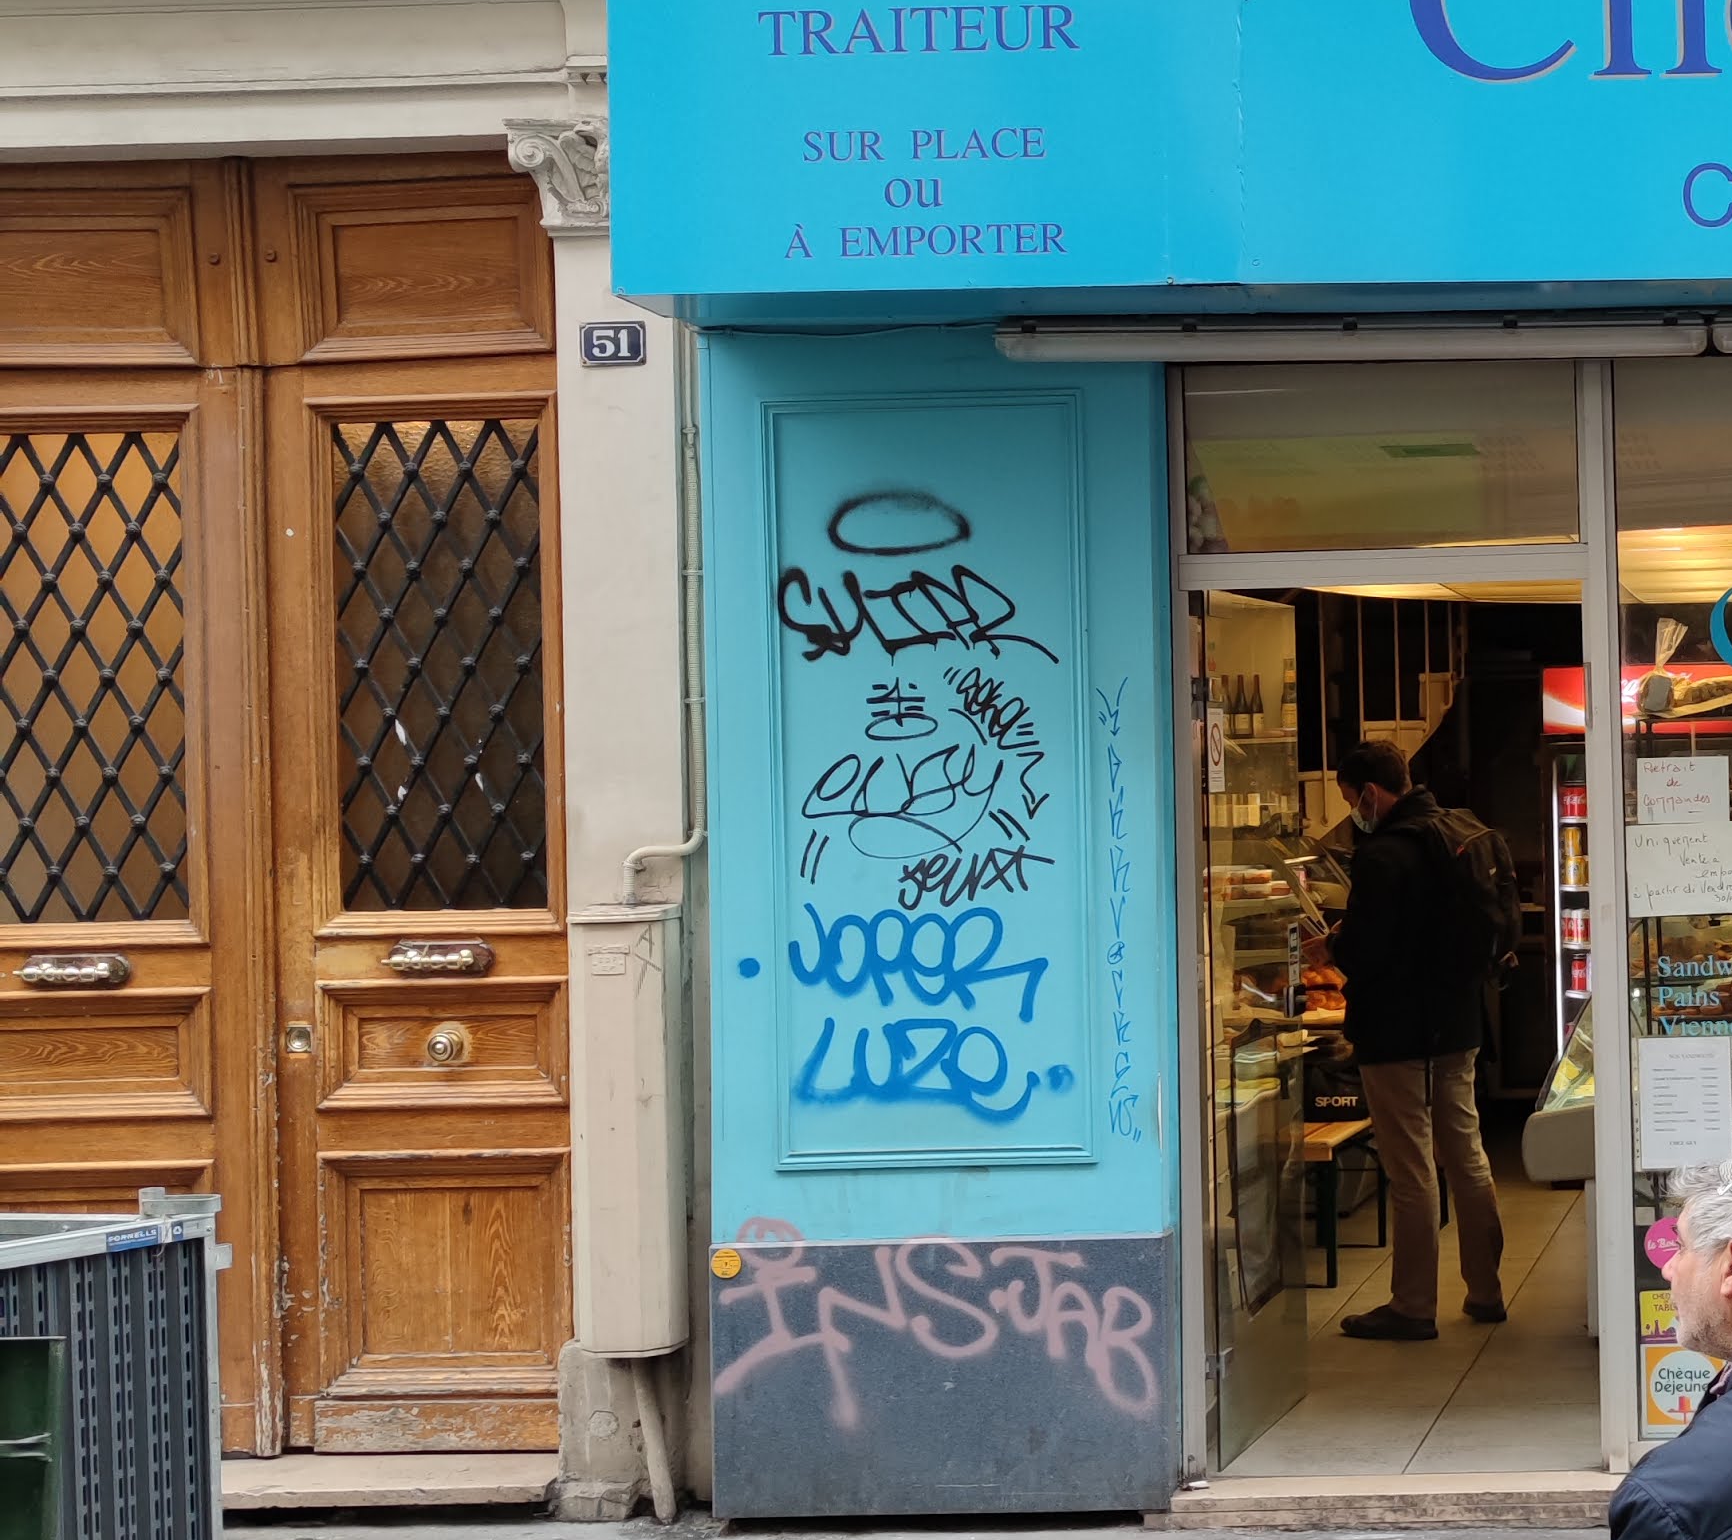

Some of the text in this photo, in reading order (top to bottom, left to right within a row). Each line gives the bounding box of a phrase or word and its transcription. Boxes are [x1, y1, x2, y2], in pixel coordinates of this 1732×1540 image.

[757, 4, 1081, 57] TRAITEUR
[802, 127, 1047, 162] SUR PLACE
[784, 222, 1068, 260] À EMPORTER
[591, 328, 632, 358] 51
[1658, 986, 1721, 1008] Pains
[1314, 1095, 1359, 1108] SPORT
[1658, 1367, 1711, 1382] Chèque
[1654, 1380, 1709, 1396] Déjeune
